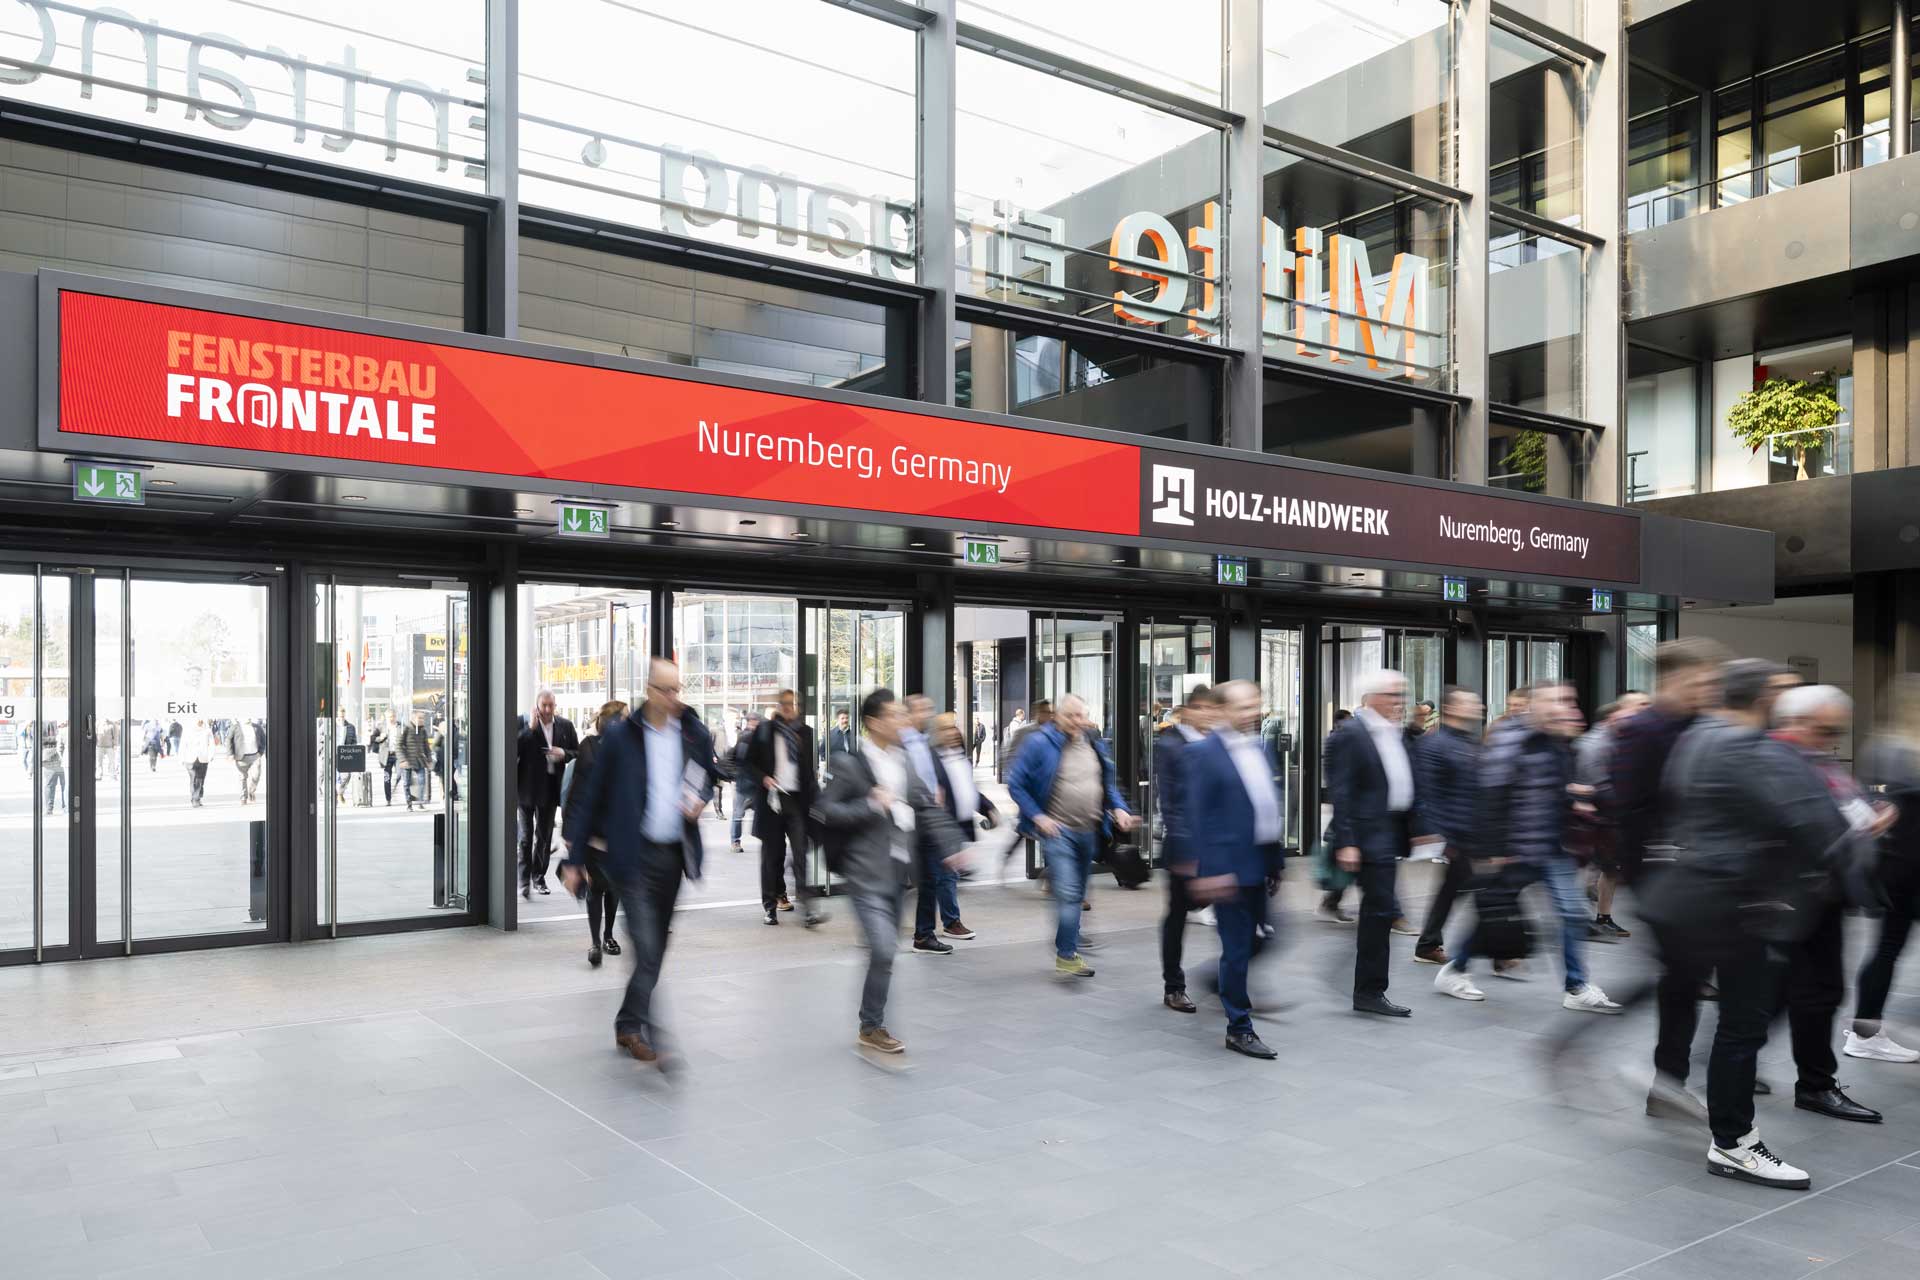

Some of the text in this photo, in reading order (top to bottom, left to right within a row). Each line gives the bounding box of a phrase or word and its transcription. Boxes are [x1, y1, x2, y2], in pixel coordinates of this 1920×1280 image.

[167, 329, 437, 400] FENSTERBAU
[167, 372, 437, 445] FRONTALE
[698, 420, 1012, 494] Nuremberg, Germany
[1205, 487, 1390, 536] HOLZ-HANDWERK
[1439, 514, 1590, 560] Nuremberg, Germany
[167, 701, 198, 714] Exit
